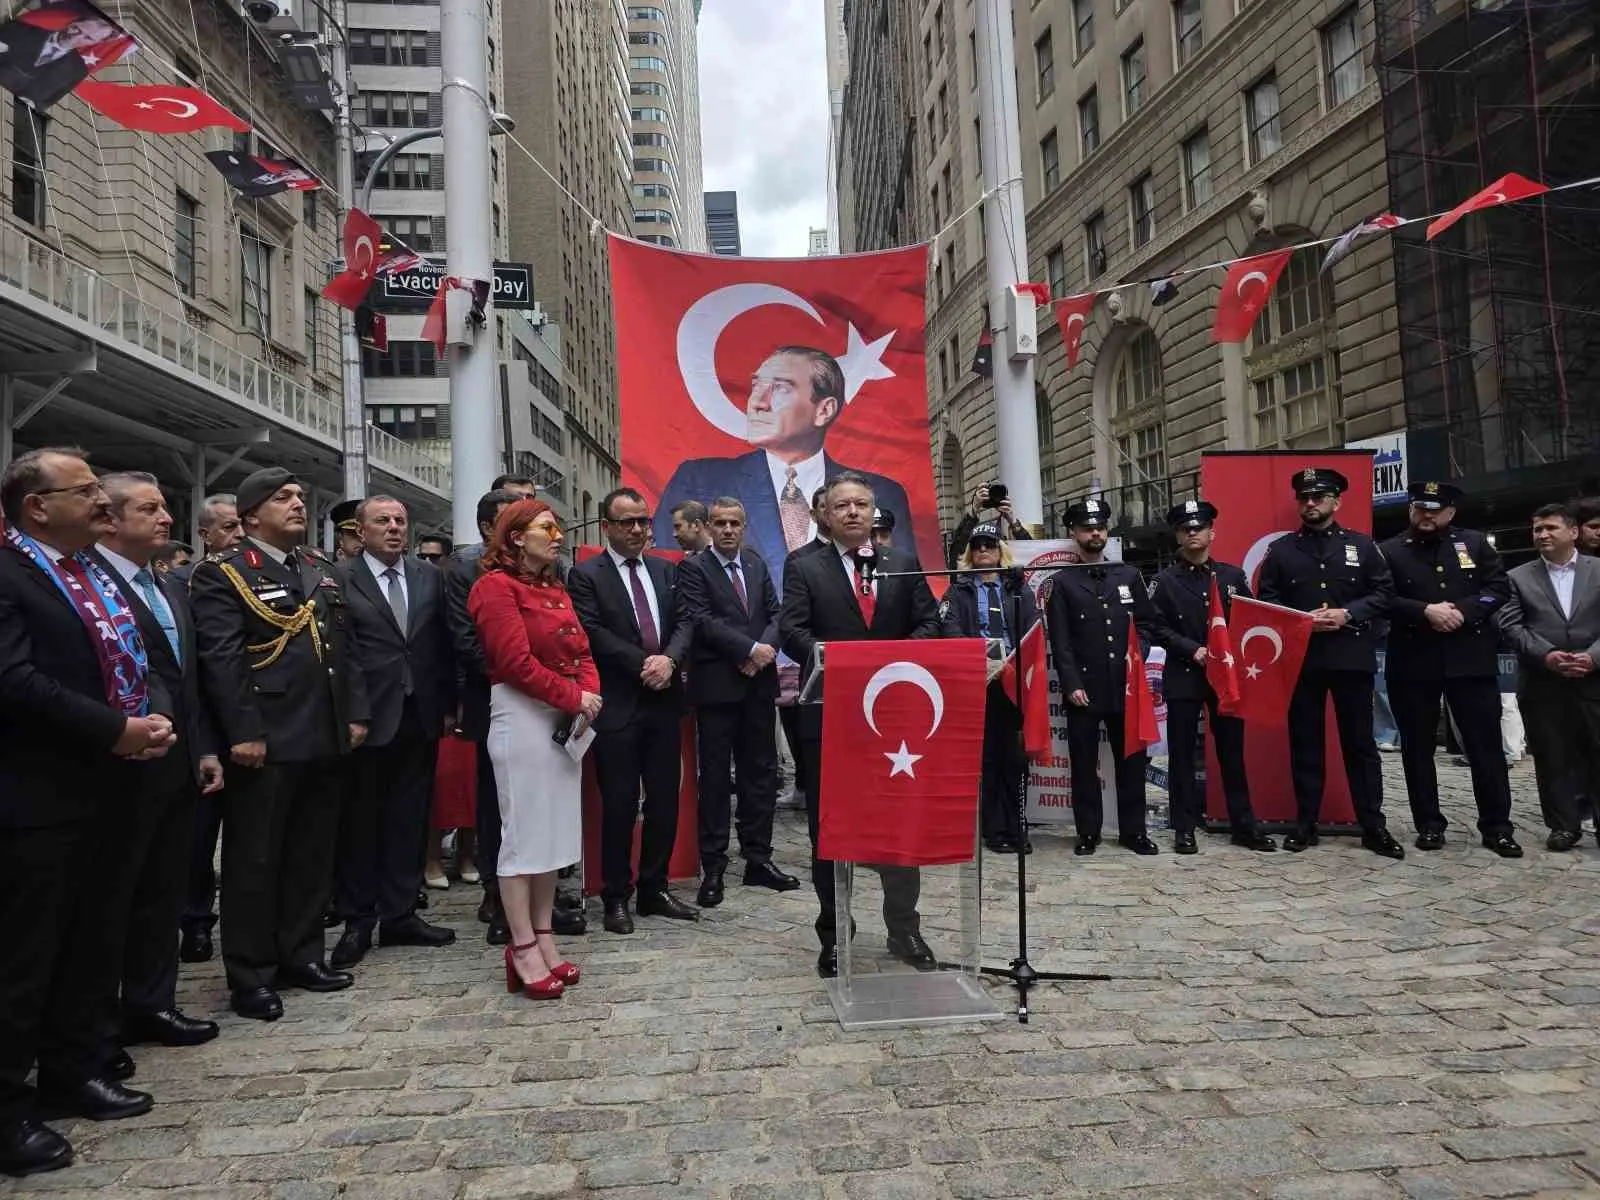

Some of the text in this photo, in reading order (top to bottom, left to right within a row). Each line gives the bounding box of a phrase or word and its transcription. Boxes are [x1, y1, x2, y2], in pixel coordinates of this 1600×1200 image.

[492, 276, 525, 299] Day
[1374, 463, 1404, 495] ENIX
[972, 524, 997, 536] NYPD
